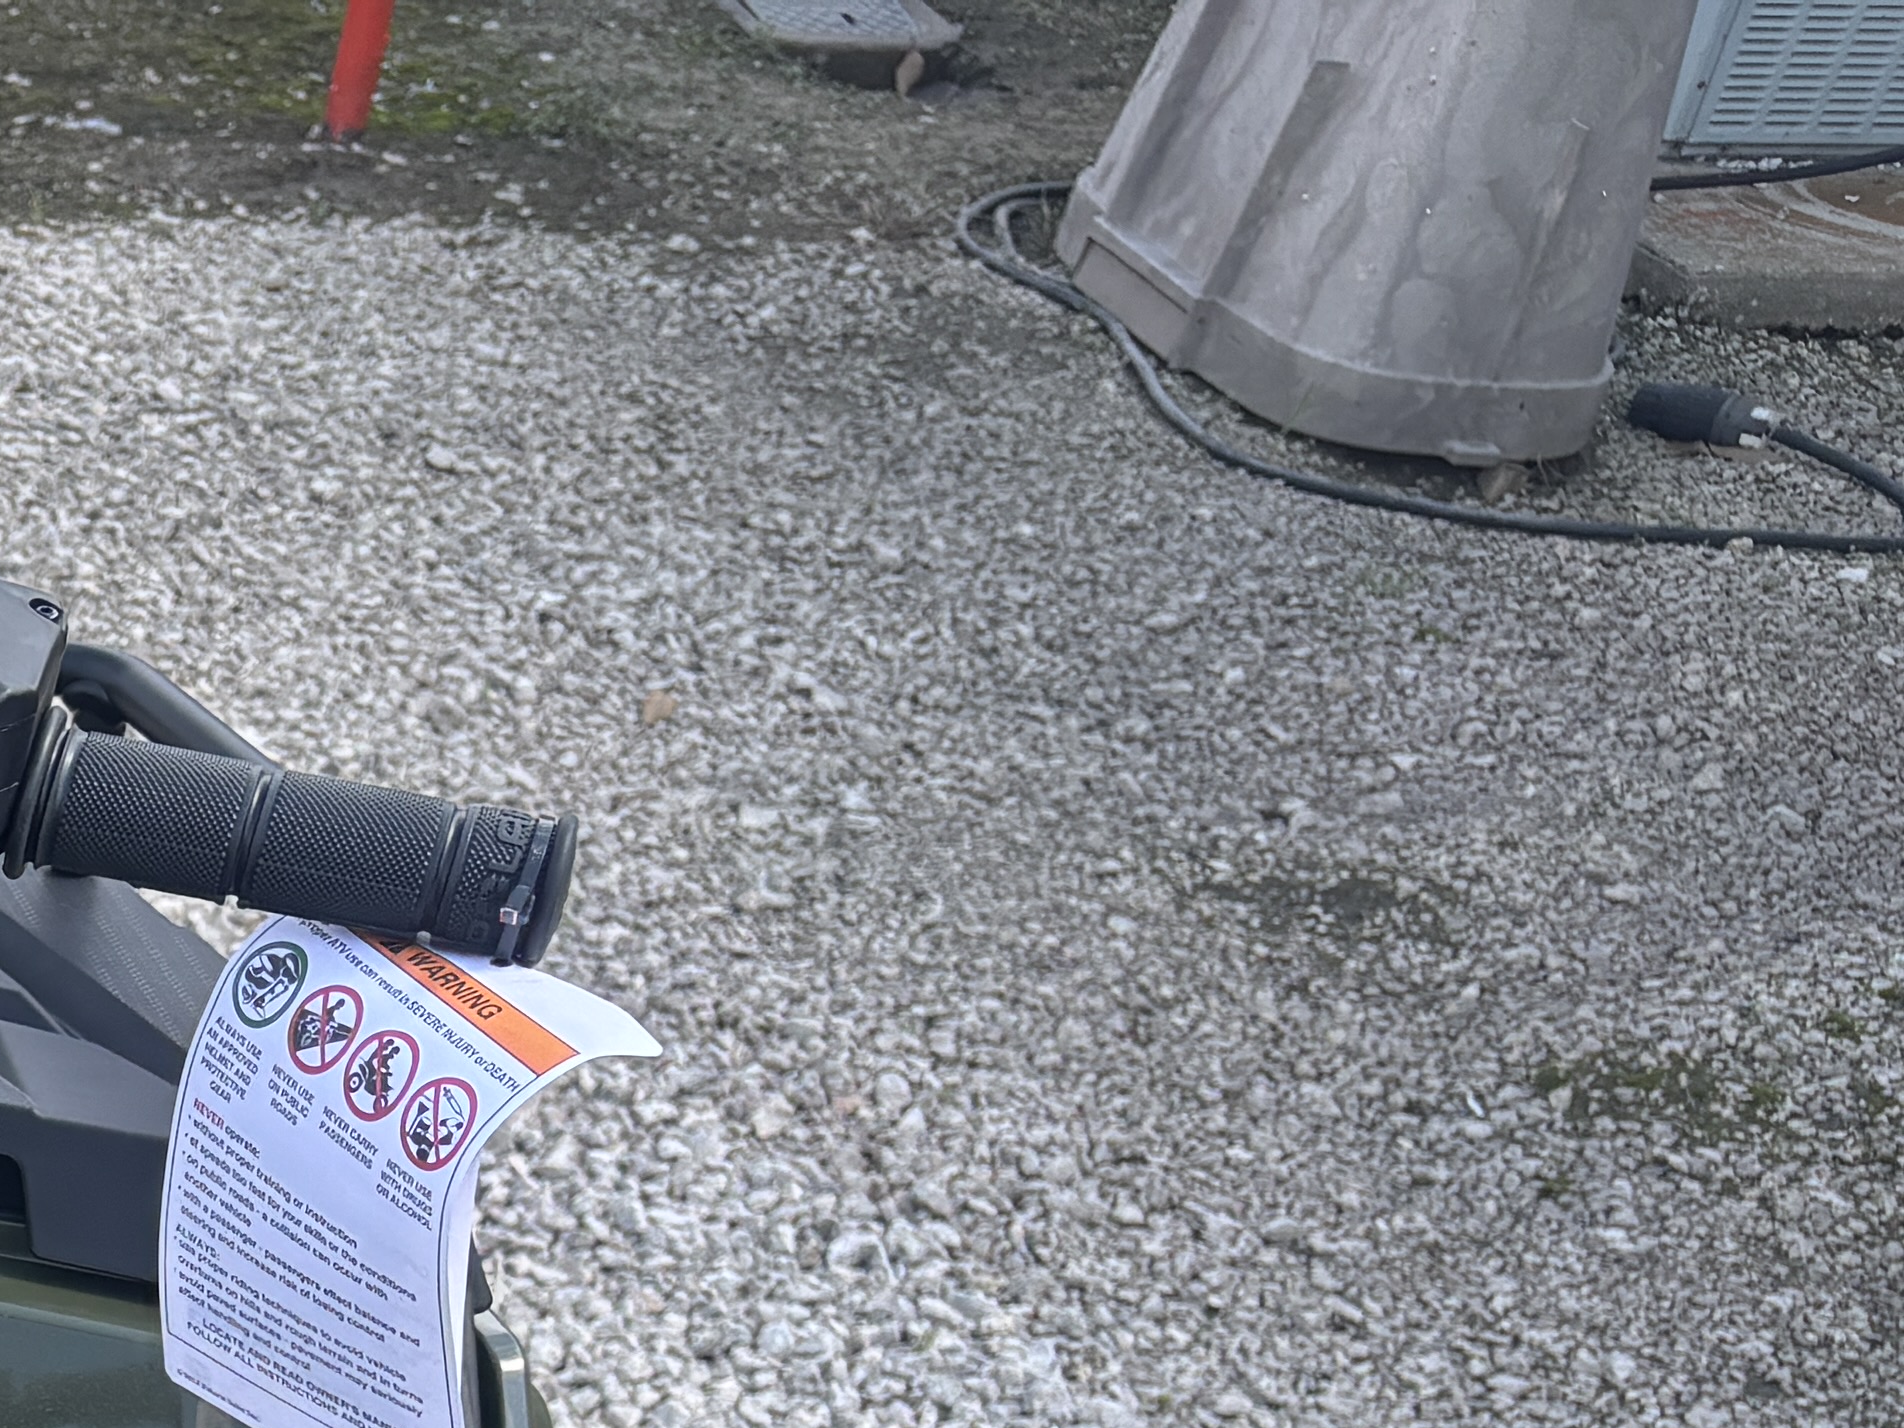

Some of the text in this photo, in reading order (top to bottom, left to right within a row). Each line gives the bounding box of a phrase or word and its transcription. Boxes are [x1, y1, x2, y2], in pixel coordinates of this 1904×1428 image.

[407, 945, 503, 1021] WARNING
[408, 999, 448, 1034] SEVERE
[485, 1061, 521, 1092] DEATH
